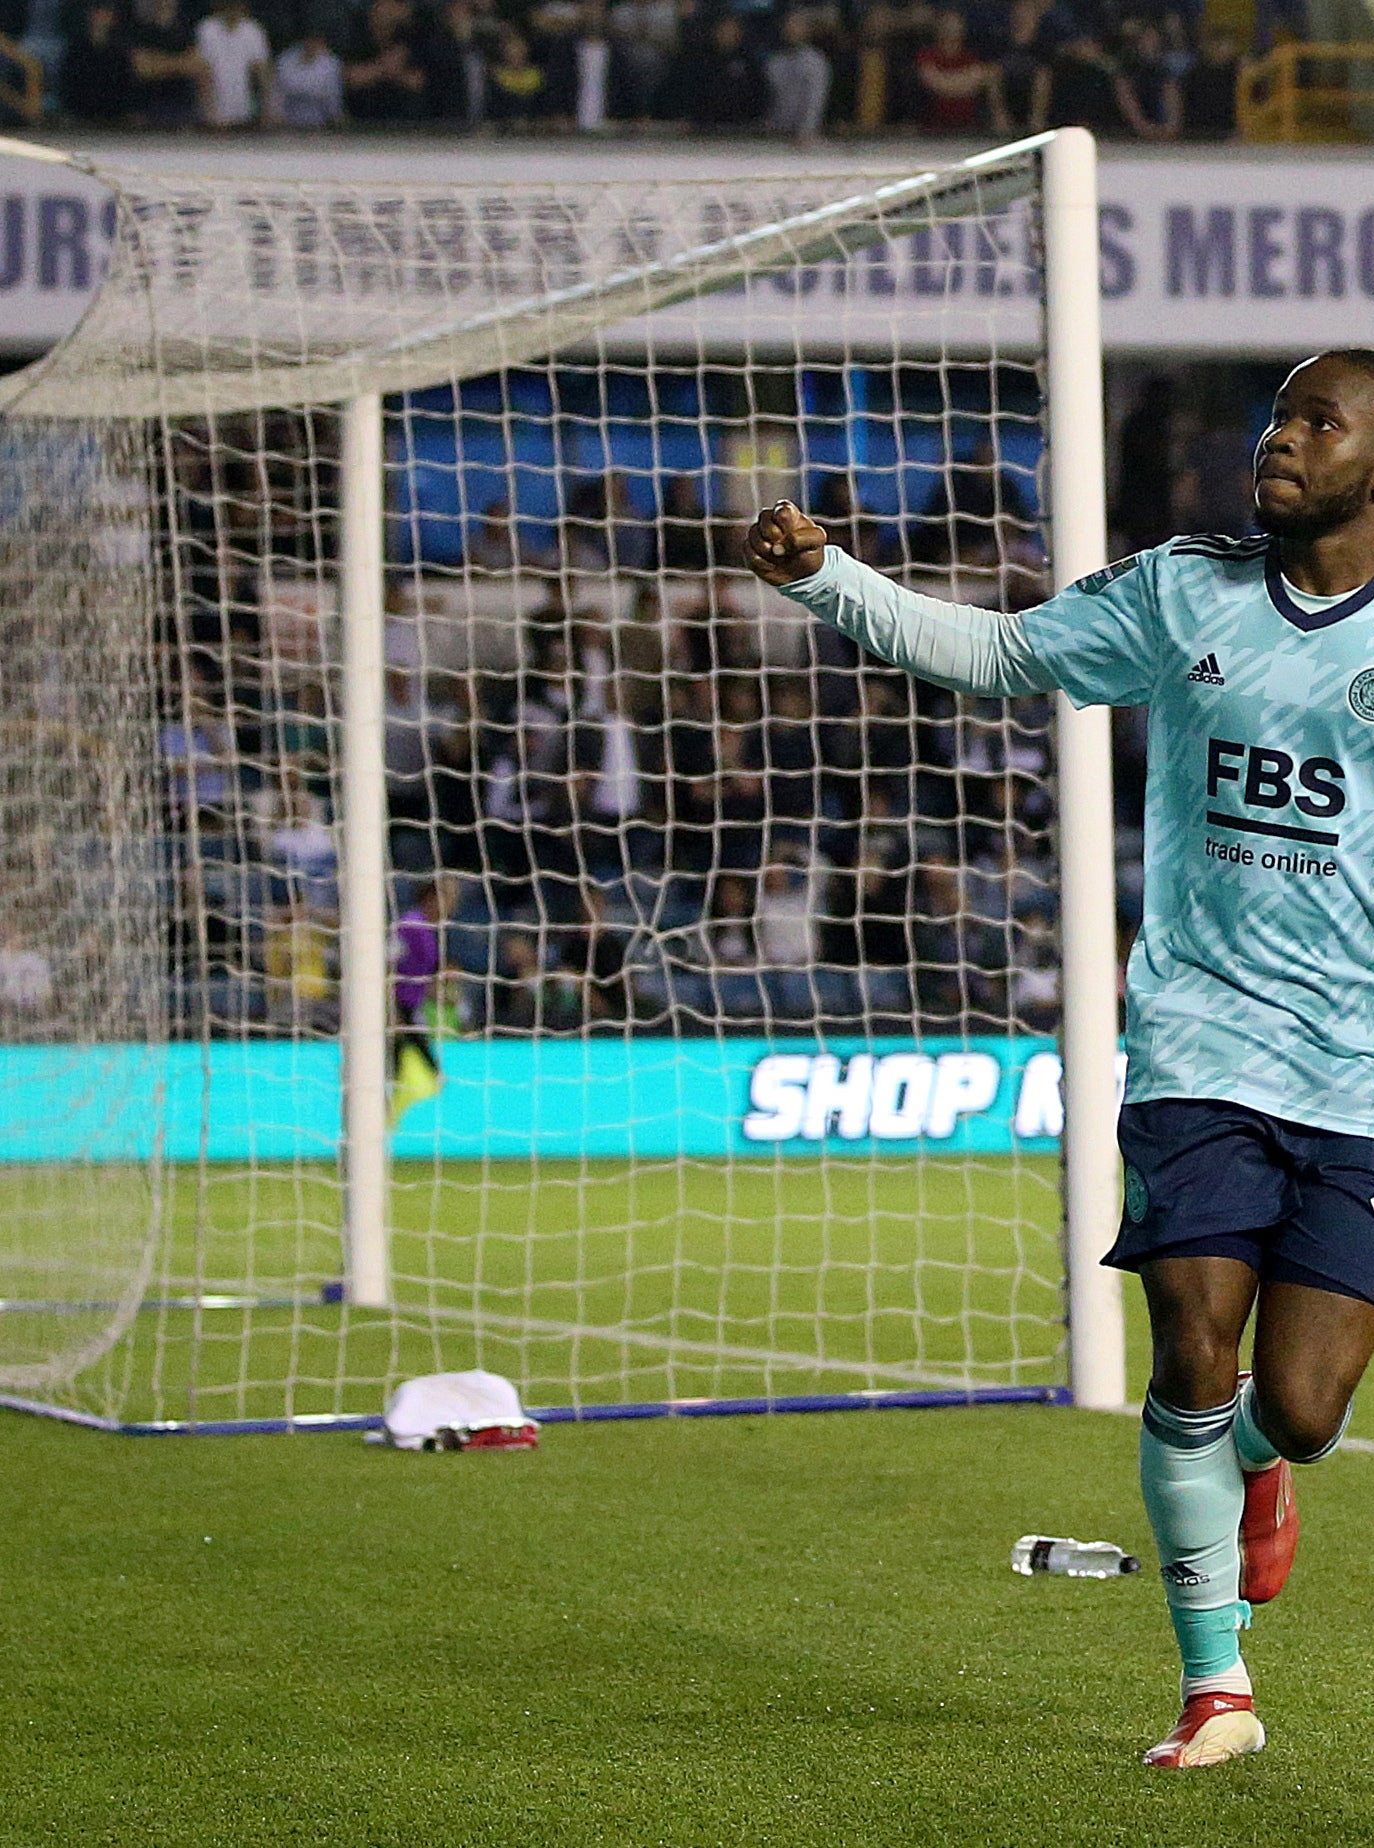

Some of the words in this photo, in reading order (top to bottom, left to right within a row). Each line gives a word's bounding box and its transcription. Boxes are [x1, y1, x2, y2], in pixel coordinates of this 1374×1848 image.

[1188, 672, 1225, 686] adidas
[1207, 738, 1346, 818] FBS
[1206, 836, 1254, 866] trade
[1261, 853, 1337, 877] online
[744, 1053, 999, 1140] SHOP
